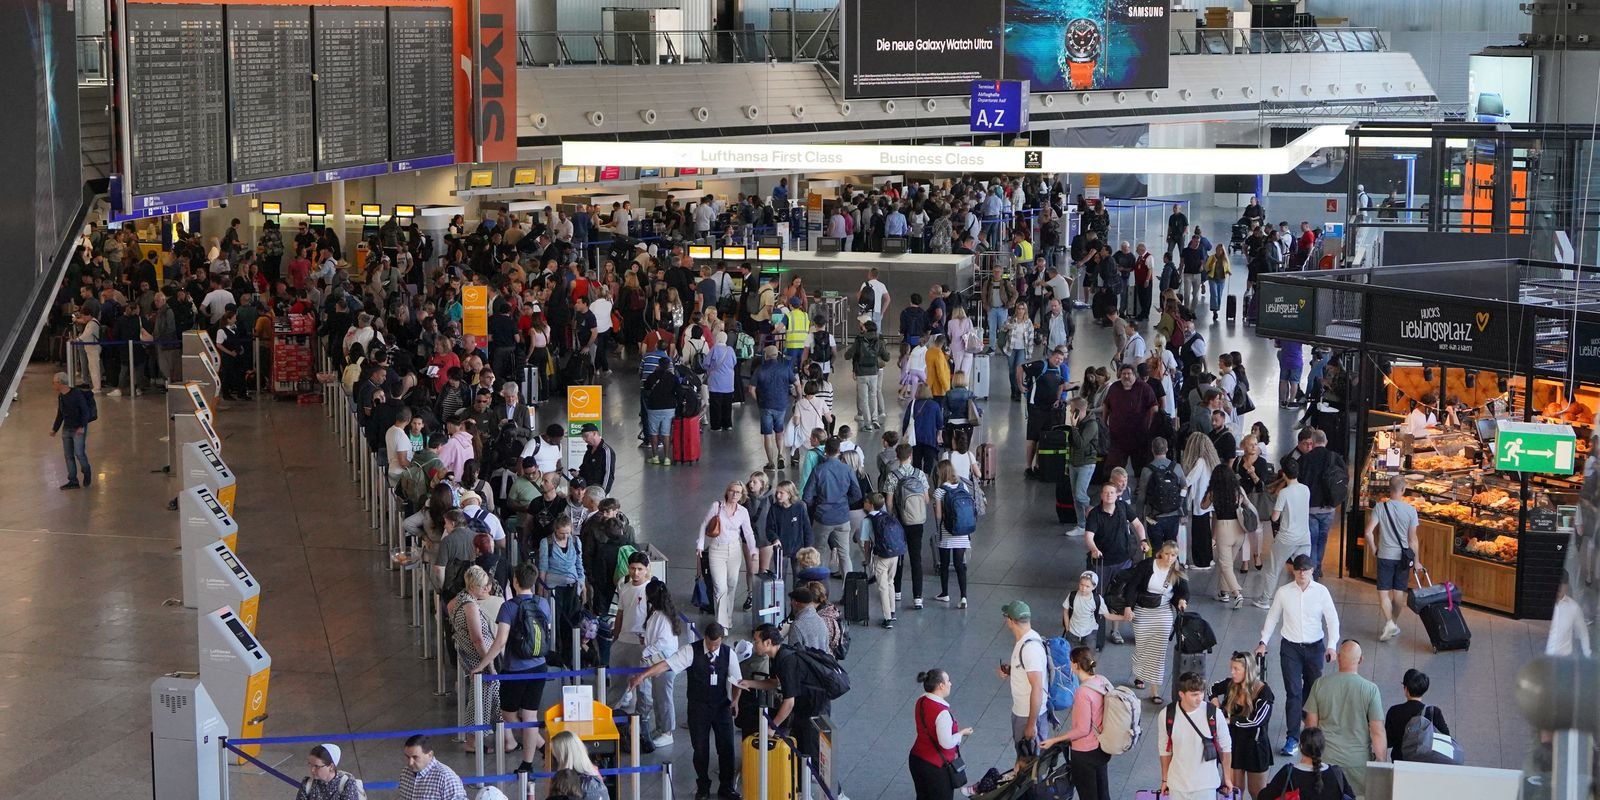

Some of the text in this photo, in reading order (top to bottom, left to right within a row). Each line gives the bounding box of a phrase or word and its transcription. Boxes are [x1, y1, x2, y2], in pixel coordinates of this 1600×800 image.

[1128, 6, 1164, 18] SAMSUNG
[876, 38, 993, 53] Die neue Galaxy Watch Ultra
[976, 109, 1005, 129] A,Z
[701, 150, 843, 164] Lufthansa First Class
[880, 152, 985, 165] Business Class
